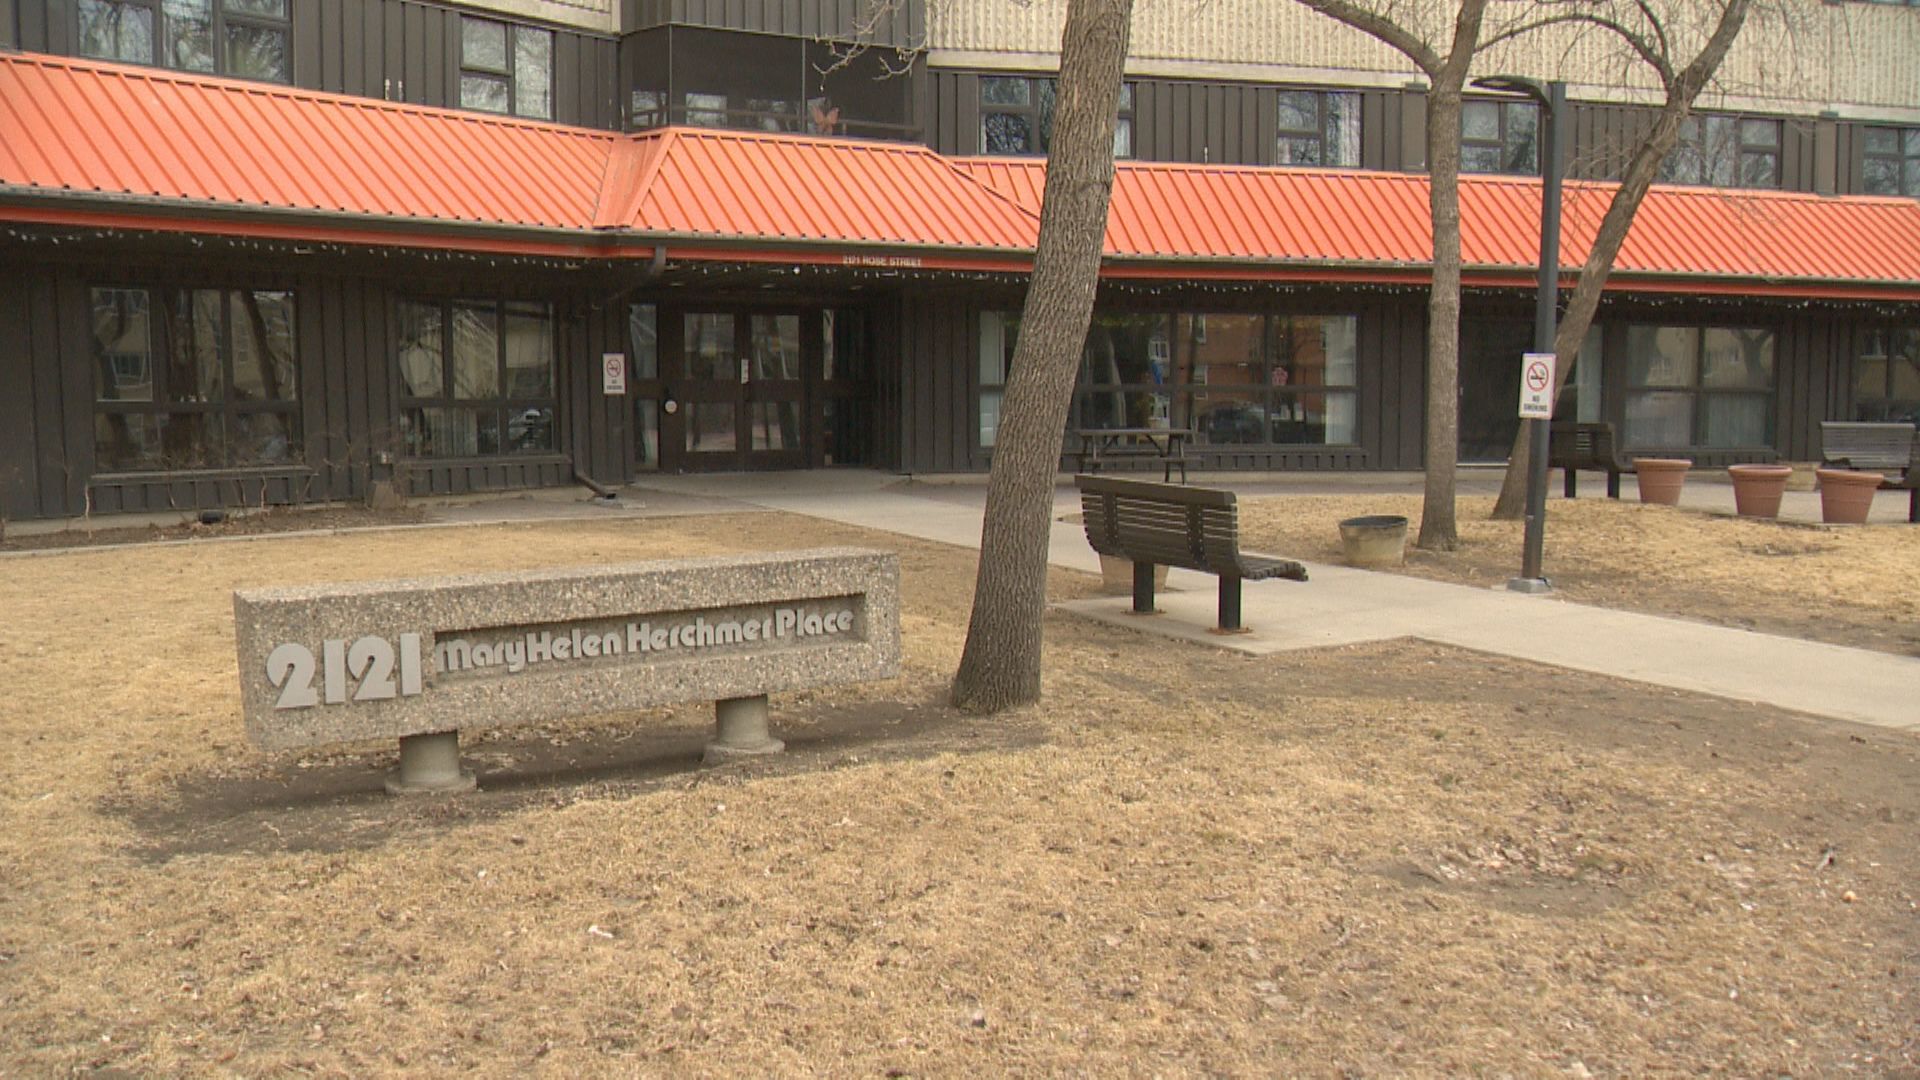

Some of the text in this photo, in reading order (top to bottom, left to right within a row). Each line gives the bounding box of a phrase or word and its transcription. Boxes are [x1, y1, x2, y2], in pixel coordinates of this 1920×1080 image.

[889, 257, 921, 268] STREET
[266, 632, 422, 710] 2121
[526, 628, 622, 663] Helen
[626, 616, 773, 653] Herchmer
[774, 608, 854, 638] Place
